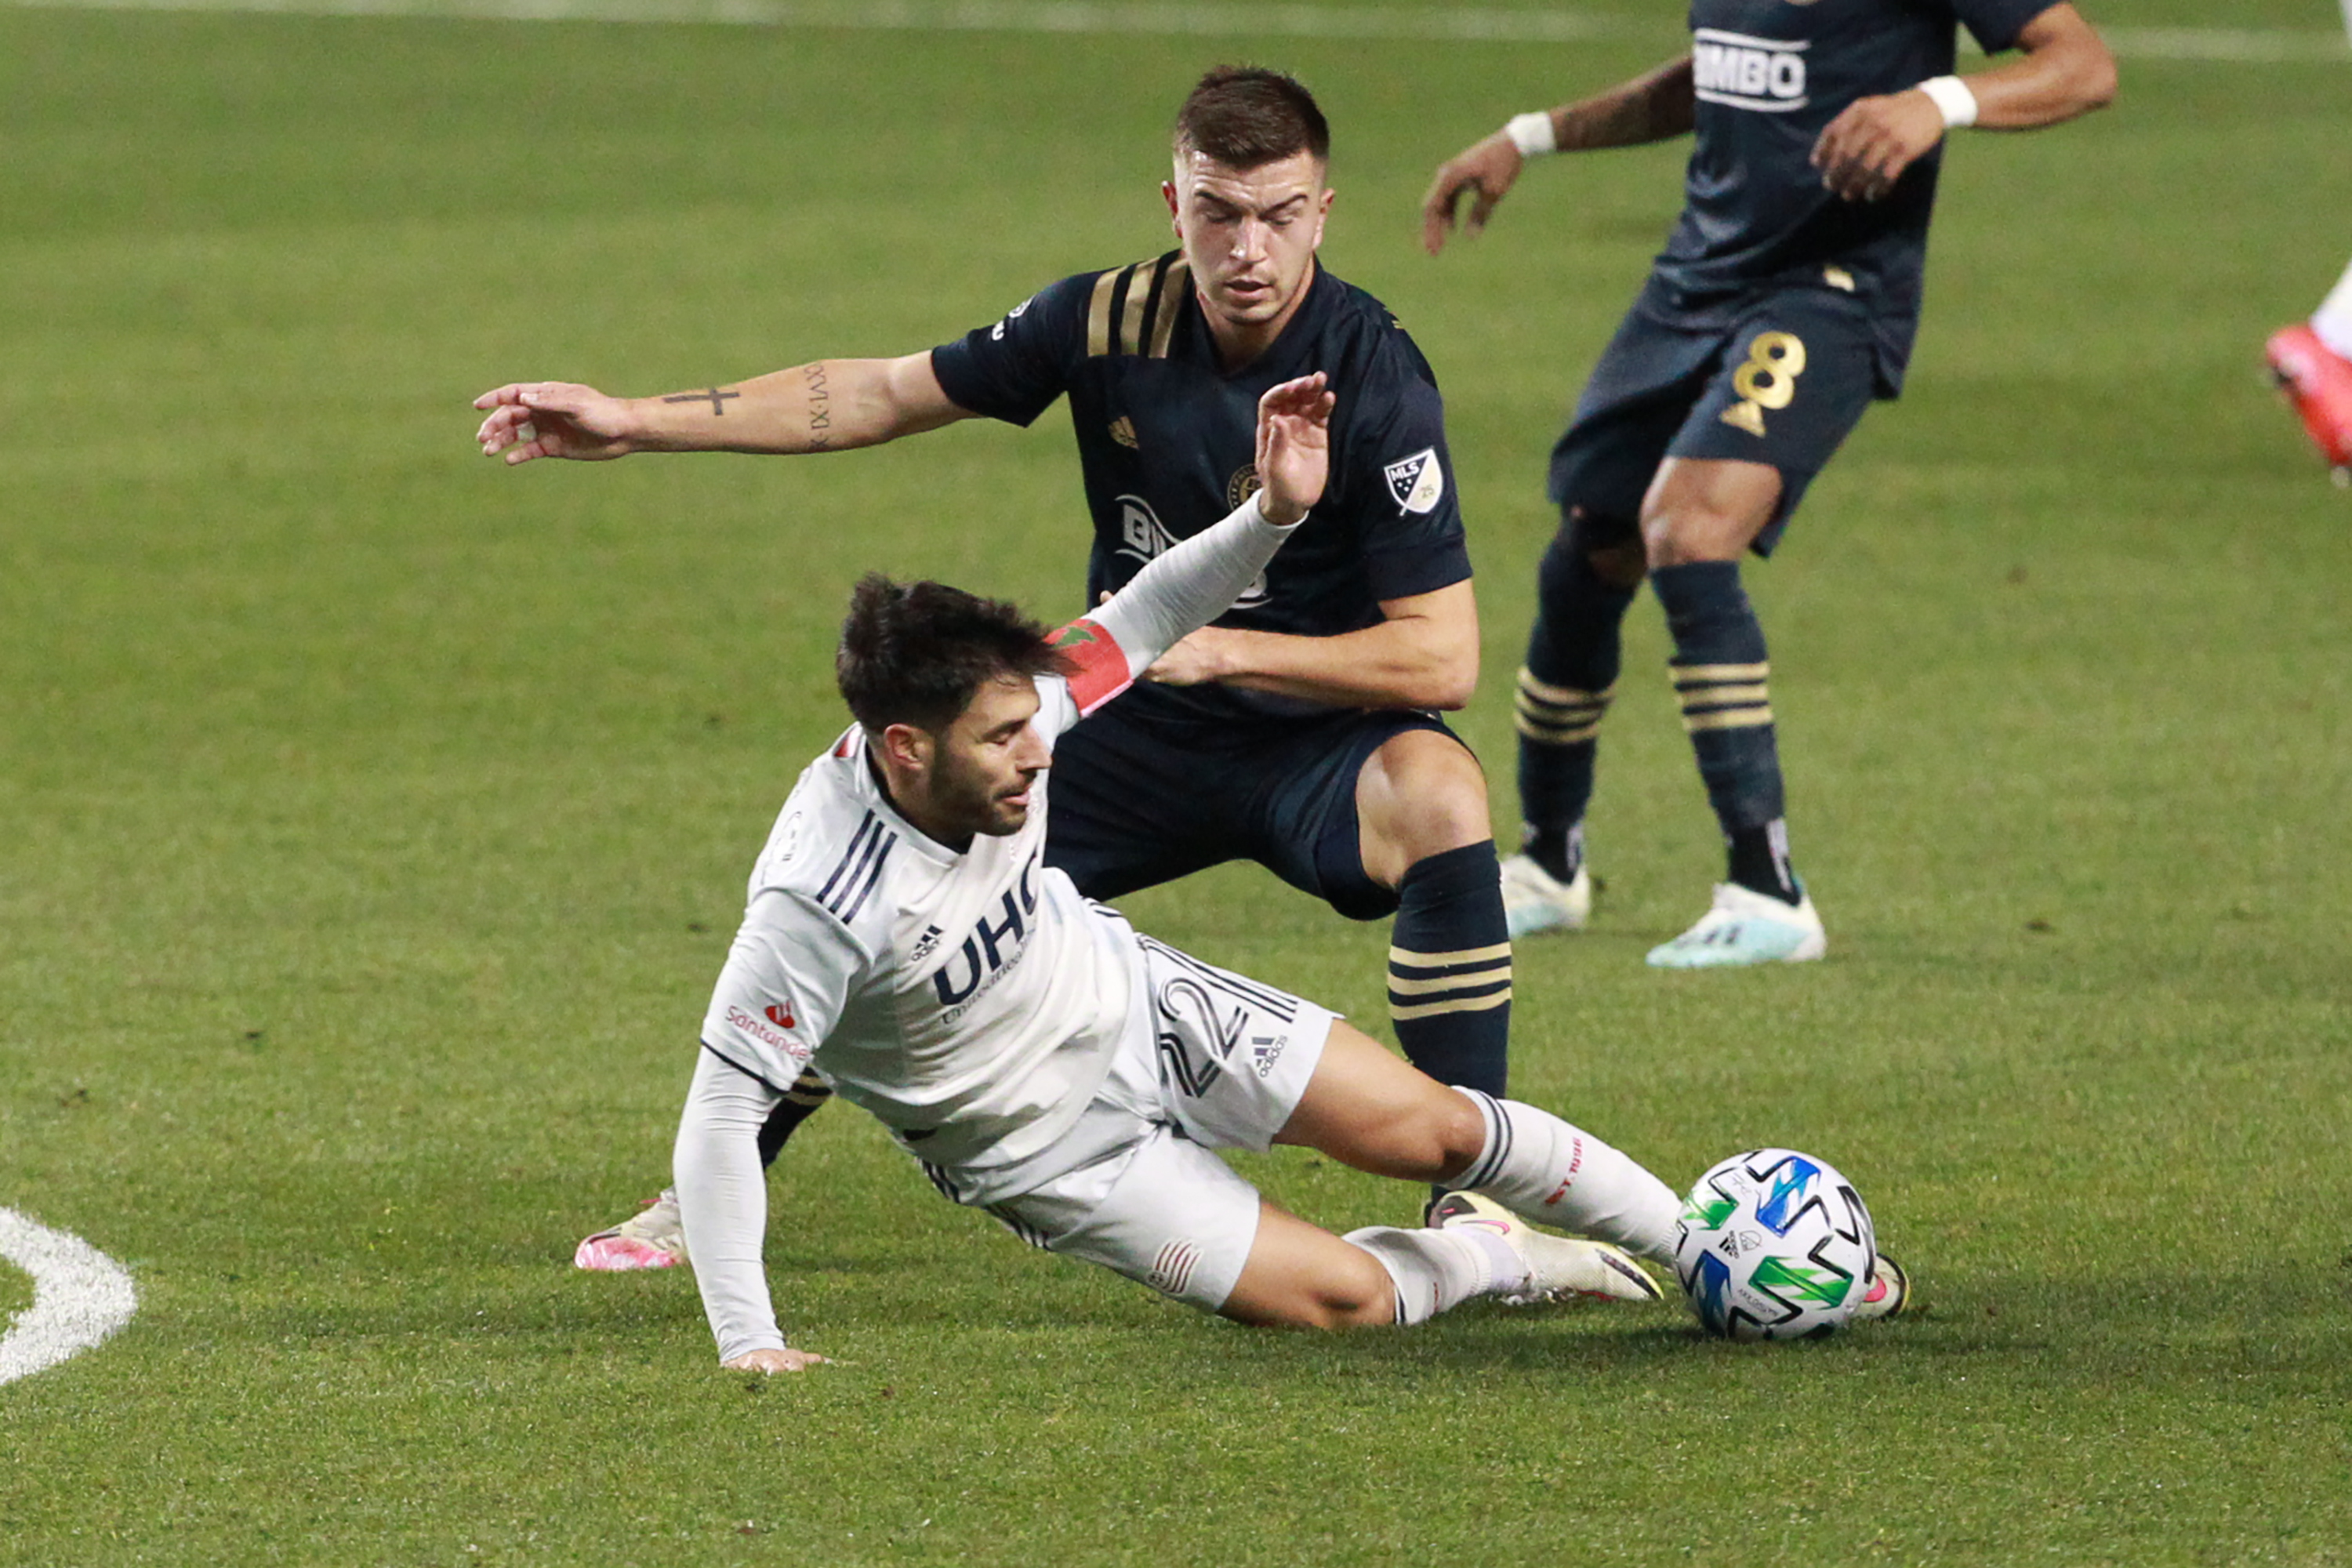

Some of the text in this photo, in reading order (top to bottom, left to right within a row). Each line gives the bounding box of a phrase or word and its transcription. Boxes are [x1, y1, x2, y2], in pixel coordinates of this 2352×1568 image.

[1732, 330, 1806, 409] 8
[1390, 462, 1420, 481] MLS
[1259, 1035, 1288, 1078] adidas
